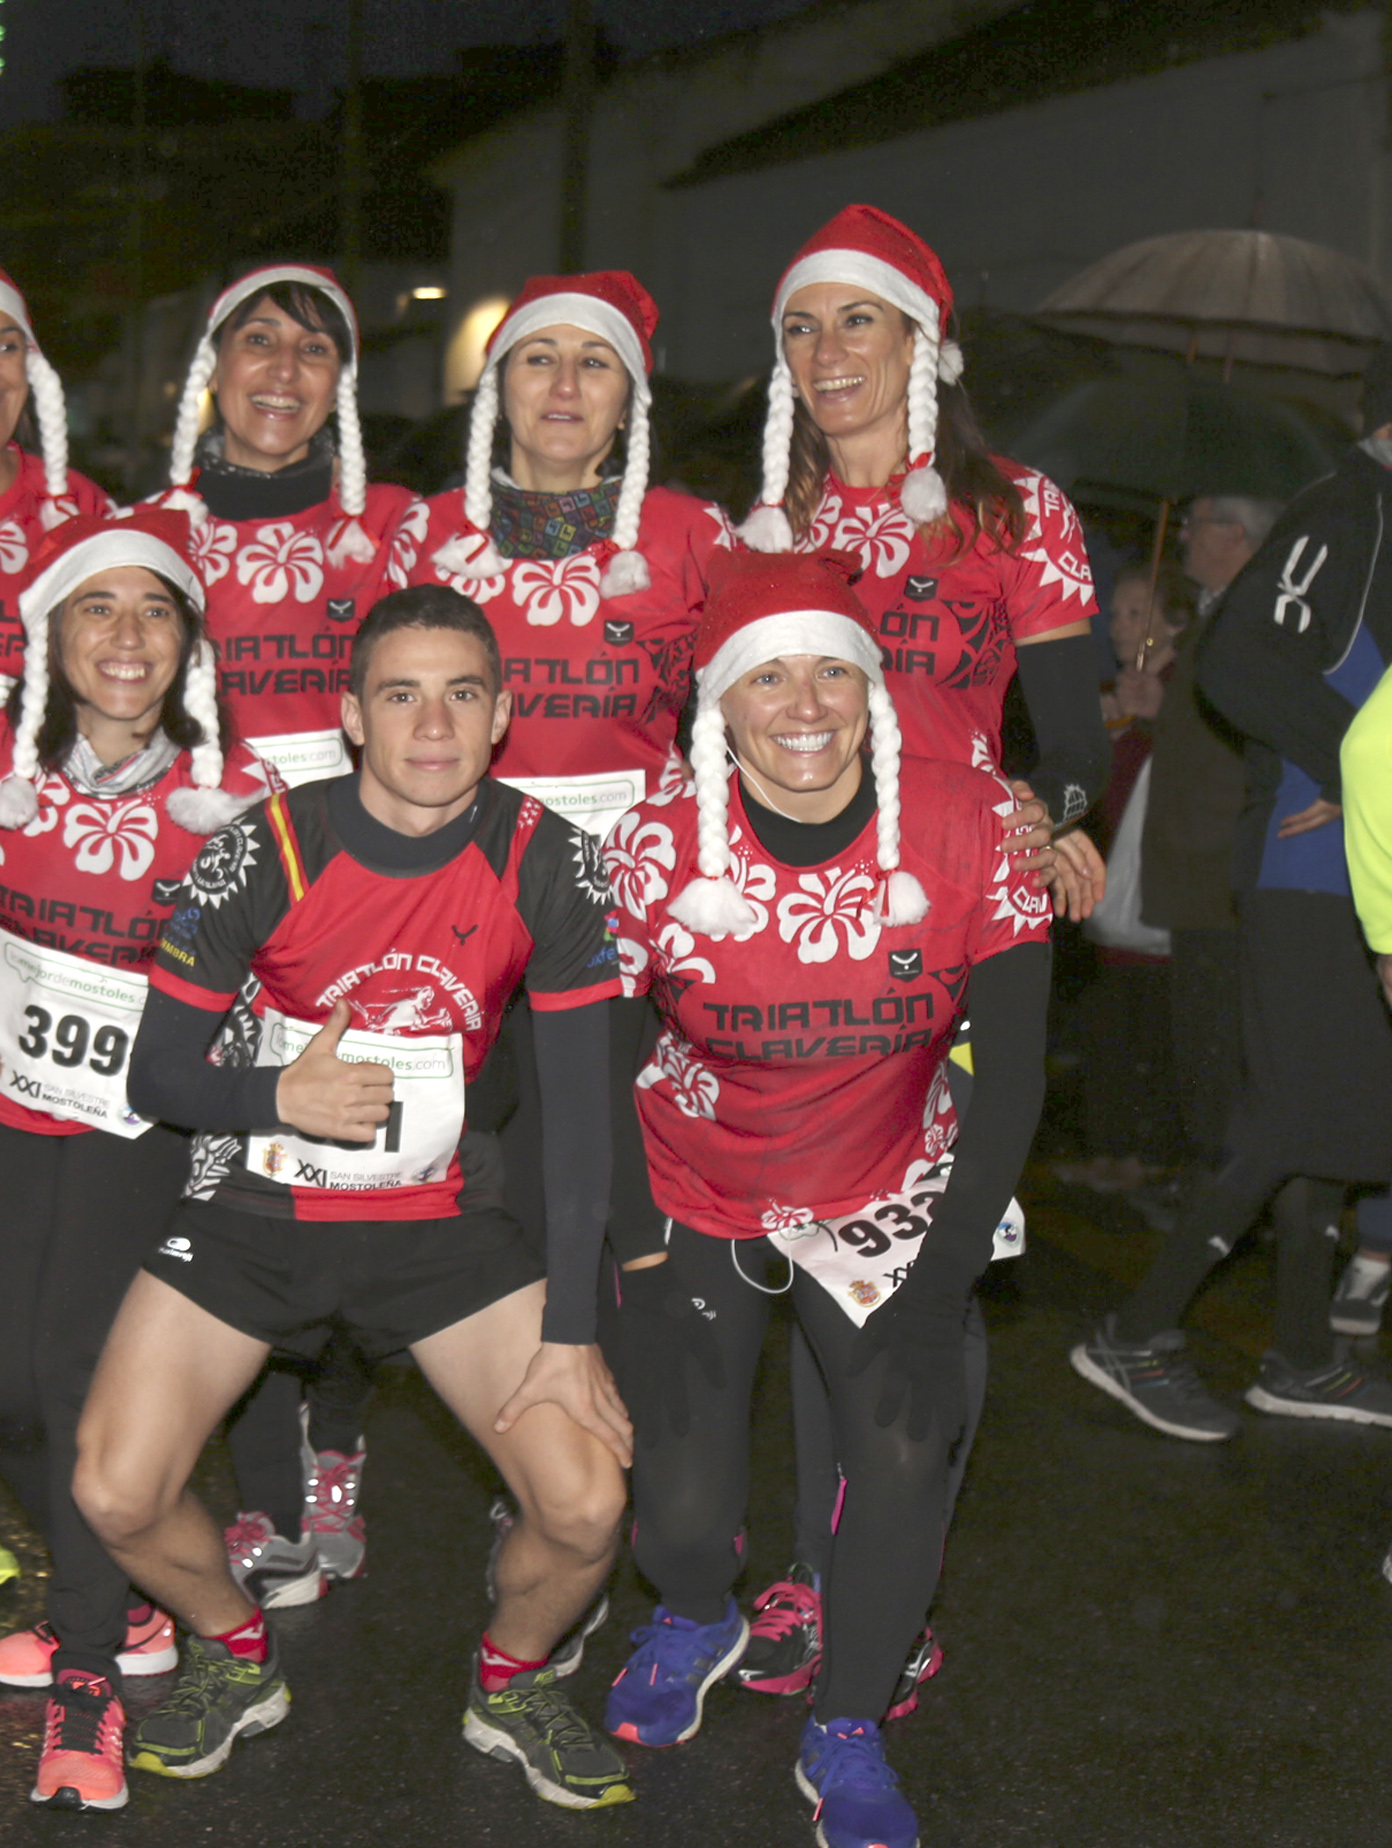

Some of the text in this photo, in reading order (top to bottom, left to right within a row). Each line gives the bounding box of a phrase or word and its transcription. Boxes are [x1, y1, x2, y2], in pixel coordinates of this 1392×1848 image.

[221, 660, 352, 696] AVERÍA
[315, 948, 485, 1032] TRIATLÓN CLAVERÍA
[703, 987, 934, 1032] TRIATLÓN
[18, 1004, 129, 1078] 399
[10, 1070, 42, 1099] XXI
[41, 1093, 108, 1119] MOSTOLEÑA
[294, 1159, 328, 1188] XXI
[329, 1171, 351, 1181] SAN
